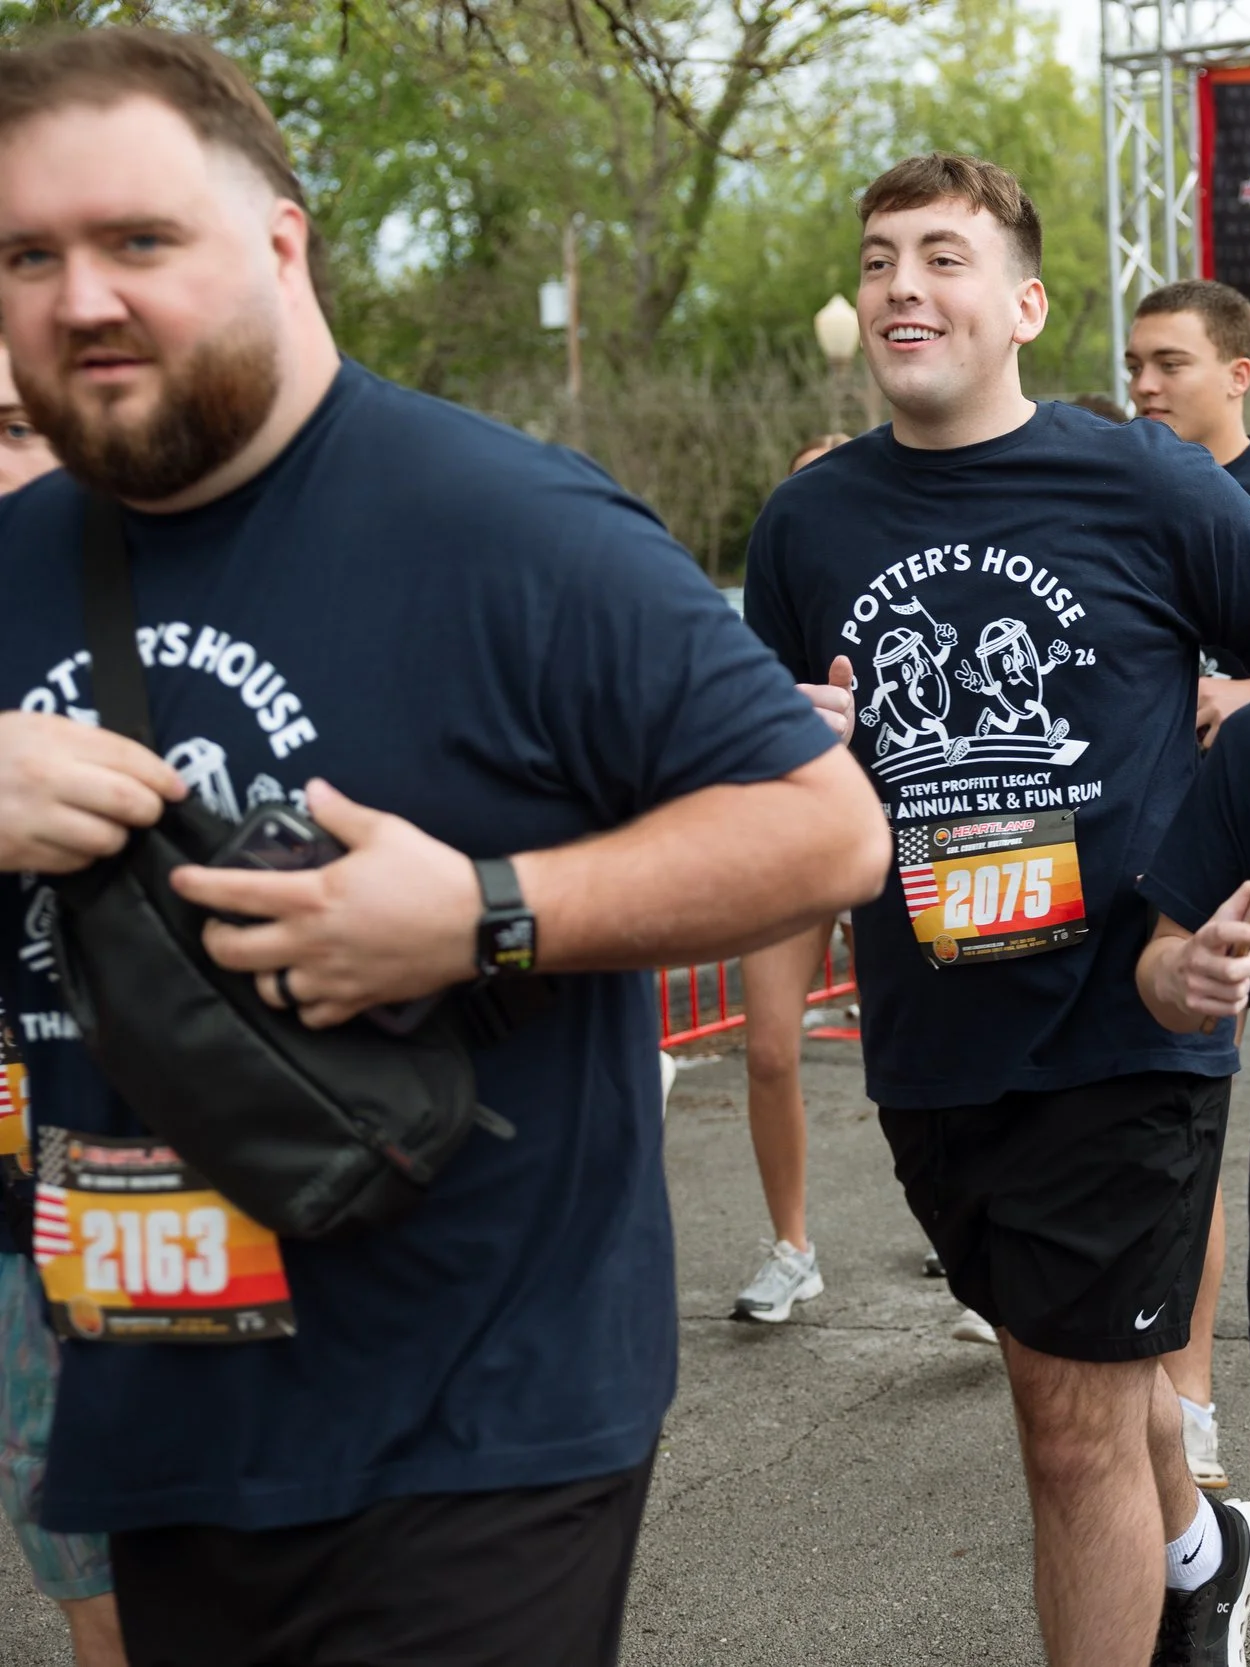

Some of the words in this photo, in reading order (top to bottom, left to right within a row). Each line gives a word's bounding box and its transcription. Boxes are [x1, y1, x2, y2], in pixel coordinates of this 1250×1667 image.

[841, 544, 971, 645] POTTER'S
[981, 547, 1086, 628] HOUSE
[1075, 648, 1096, 666] 26
[188, 624, 318, 760] HOUSE
[897, 795, 972, 819] ANNUAL
[977, 793, 1000, 811] 5K
[1006, 792, 1020, 808] &
[1025, 787, 1063, 808] FUN
[1068, 780, 1102, 804] RUN
[900, 782, 938, 797] STEVE
[942, 776, 999, 792] PROFFITT
[1002, 772, 1051, 787] LEGACY
[952, 819, 1035, 839] HEARTLAND
[943, 857, 1053, 929] 2075
[81, 1207, 229, 1297] 2163
